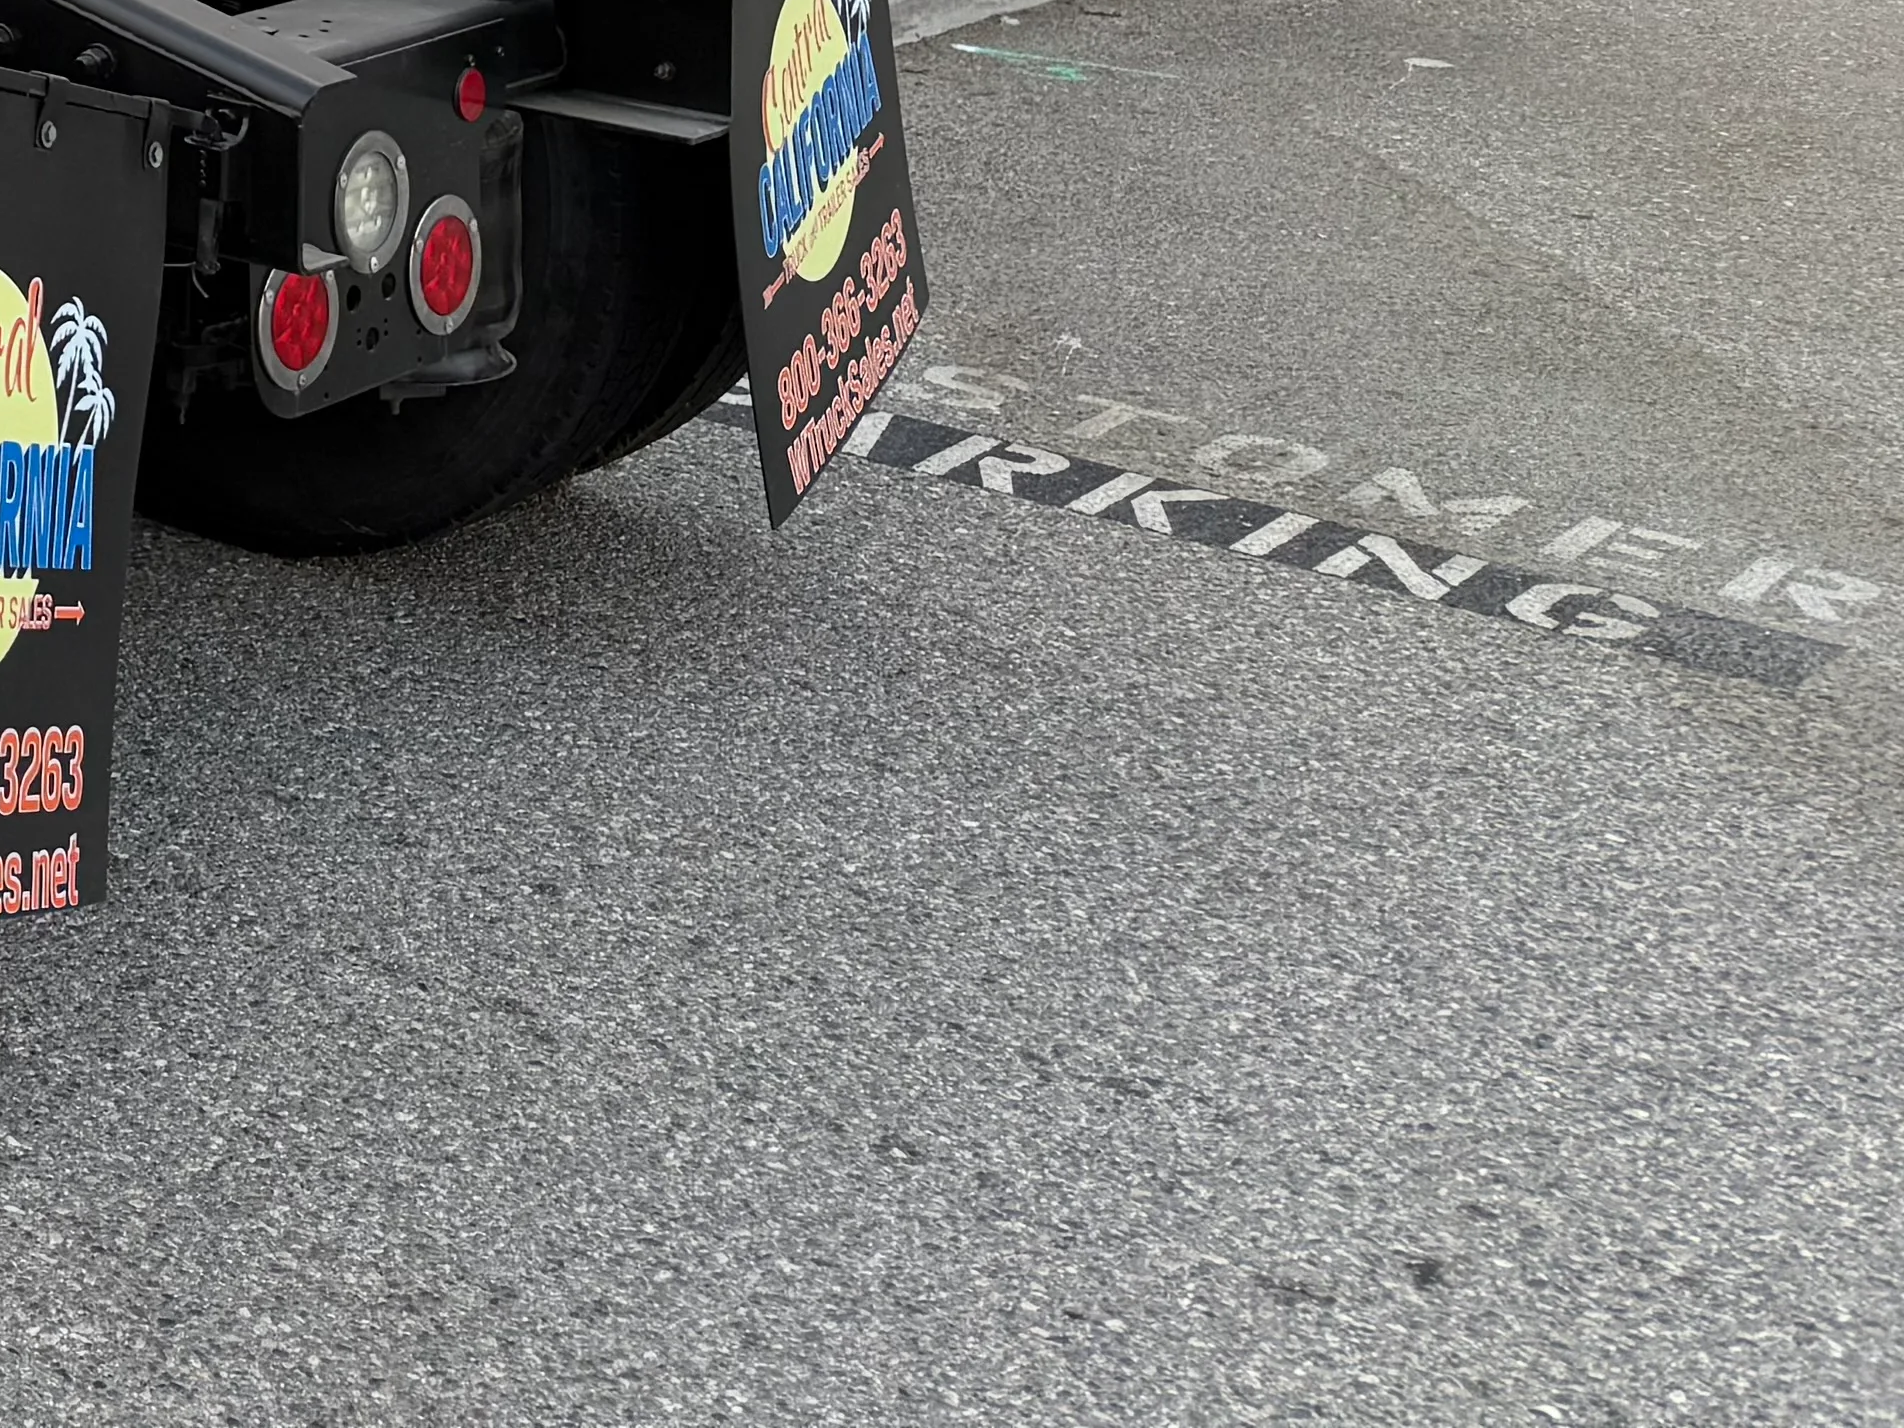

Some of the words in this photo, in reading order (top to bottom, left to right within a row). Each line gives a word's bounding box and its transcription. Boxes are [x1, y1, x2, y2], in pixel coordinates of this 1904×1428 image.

[758, 28, 882, 260] CALIFORNIA
[782, 235, 810, 285] TRUCK
[817, 176, 848, 230] TRAILER
[777, 207, 908, 432] 800-366-3263
[786, 275, 920, 496] WTruckSales.net
[922, 362, 1884, 624] STOMER
[8, 592, 54, 631] SALES
